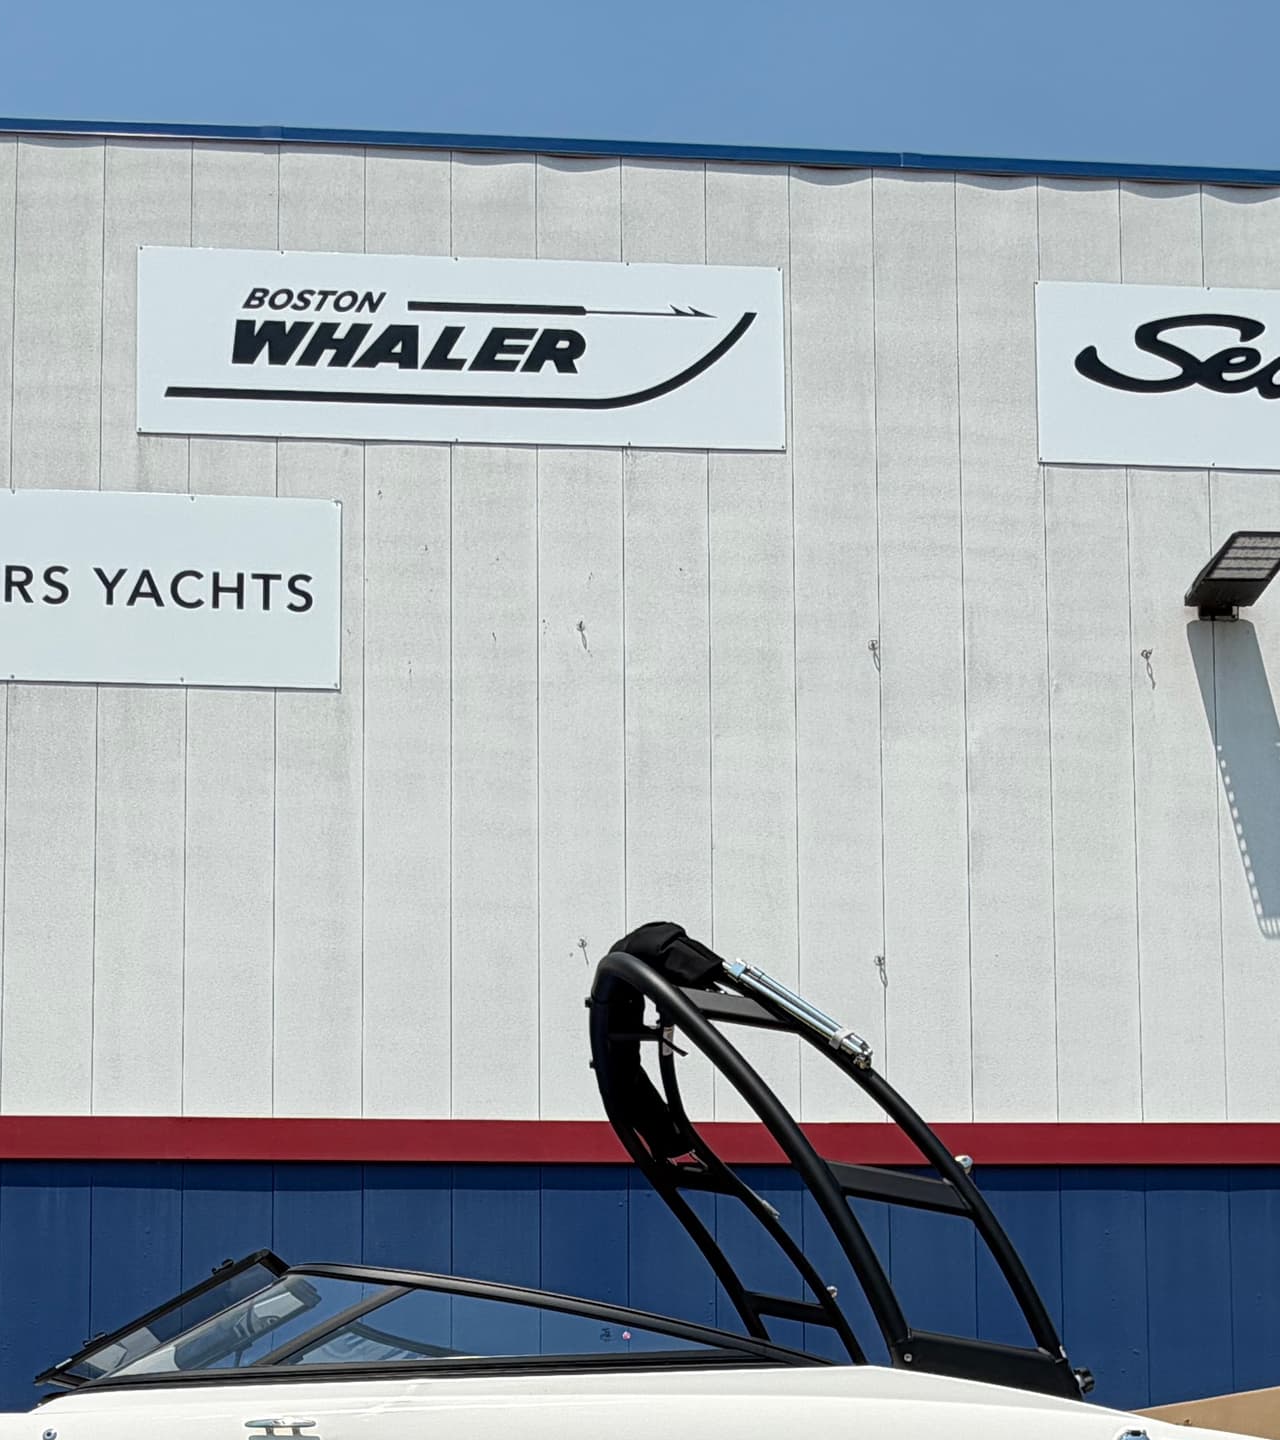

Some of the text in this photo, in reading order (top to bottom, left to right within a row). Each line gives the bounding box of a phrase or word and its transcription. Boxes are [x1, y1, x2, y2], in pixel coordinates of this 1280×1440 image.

[242, 287, 387, 313] BOSTON
[231, 318, 587, 374] WHALER
[93, 567, 314, 613] YACHTS
